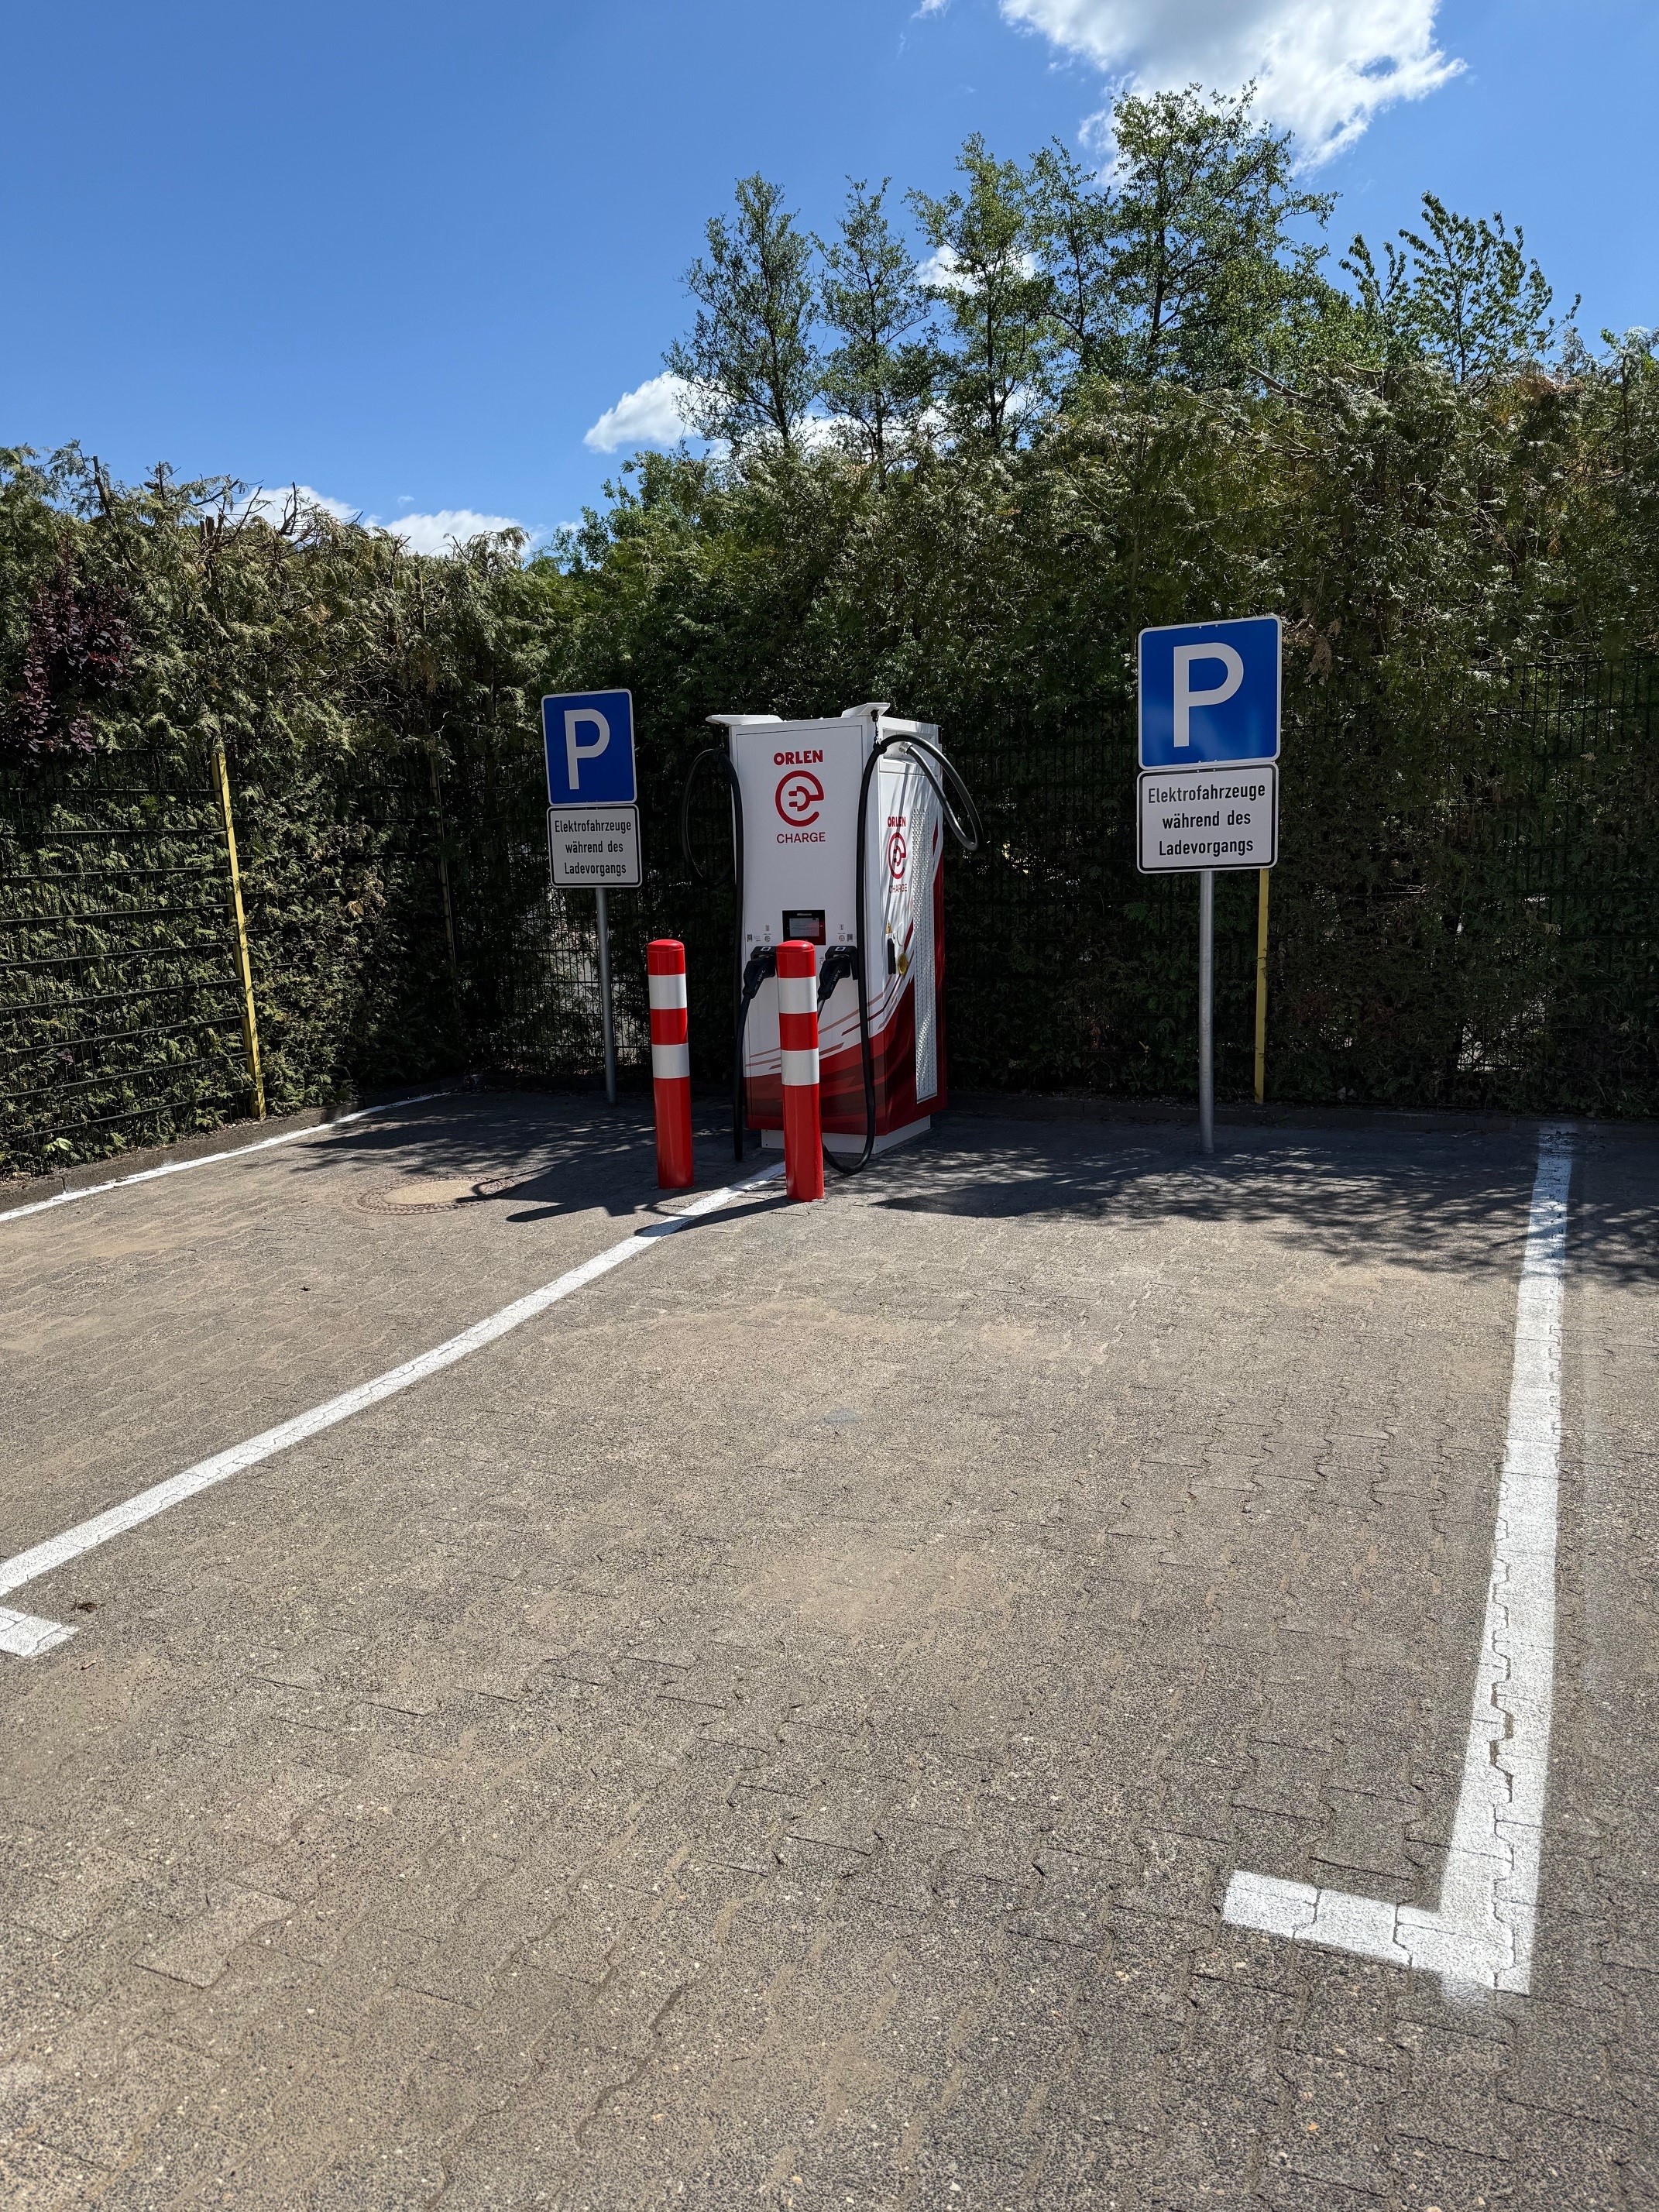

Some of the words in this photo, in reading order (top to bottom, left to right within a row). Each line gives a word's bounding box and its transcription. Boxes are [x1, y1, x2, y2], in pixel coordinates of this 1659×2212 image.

[1173, 642, 1244, 747] P
[564, 709, 610, 790] P
[774, 750, 823, 766] ORLEN
[1148, 784, 1266, 804] Elektrofahrzeuge
[555, 819, 631, 835] Elektrofahrzeuge
[887, 816, 906, 827] ORLEN
[1162, 810, 1220, 830] während
[1226, 810, 1251, 826] des
[777, 832, 826, 843] CHARGE
[565, 840, 603, 854] während
[608, 840, 623, 853] des
[1159, 840, 1253, 857] Ladevorgangs
[565, 862, 626, 877] Ladevorgangs
[888, 884, 908, 893] CHARGE
